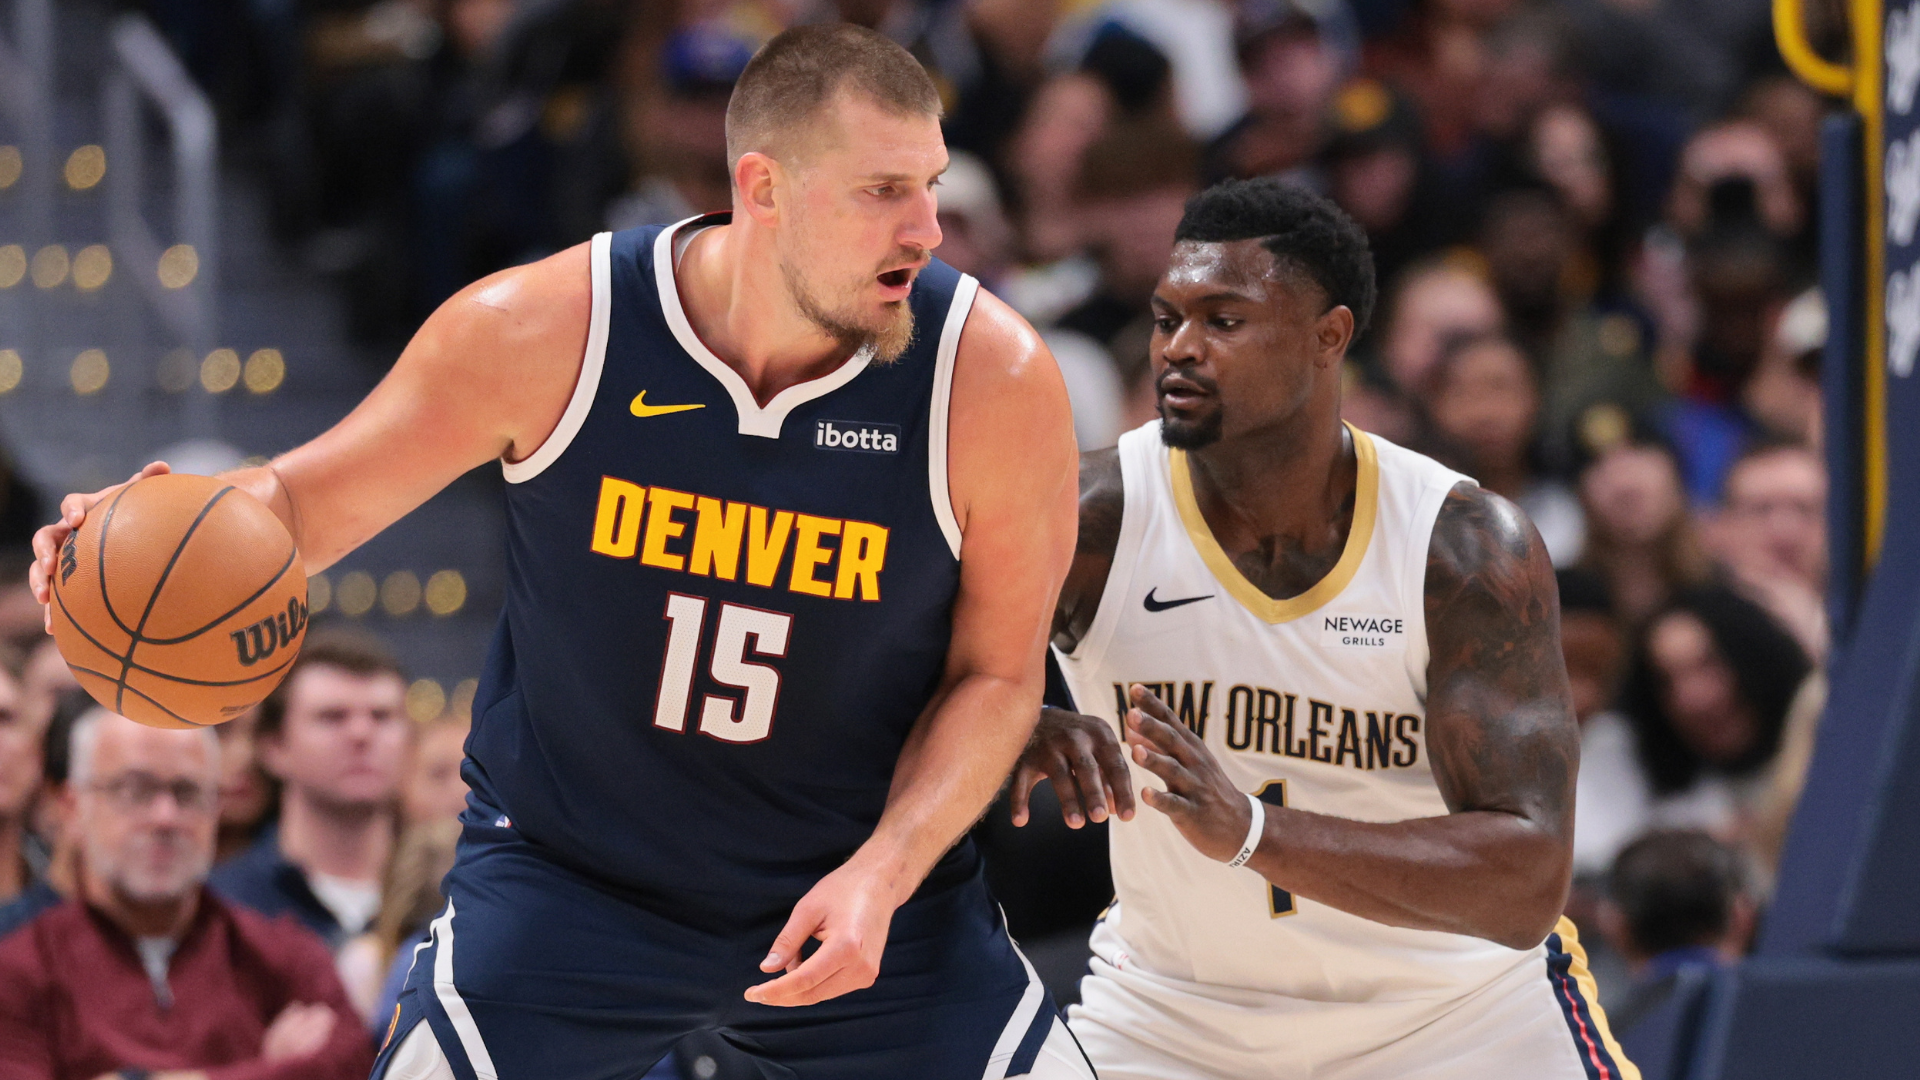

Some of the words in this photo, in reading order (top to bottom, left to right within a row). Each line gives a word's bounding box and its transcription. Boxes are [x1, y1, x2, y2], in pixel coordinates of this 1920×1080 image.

[816, 422, 898, 452] ibotta
[590, 474, 891, 602] DENVER
[229, 596, 309, 667] Wils
[1324, 616, 1403, 634] NEWAGE
[1342, 636, 1385, 647] GRILLS
[652, 591, 794, 744] 15
[1225, 683, 1421, 770] ORLEANS
